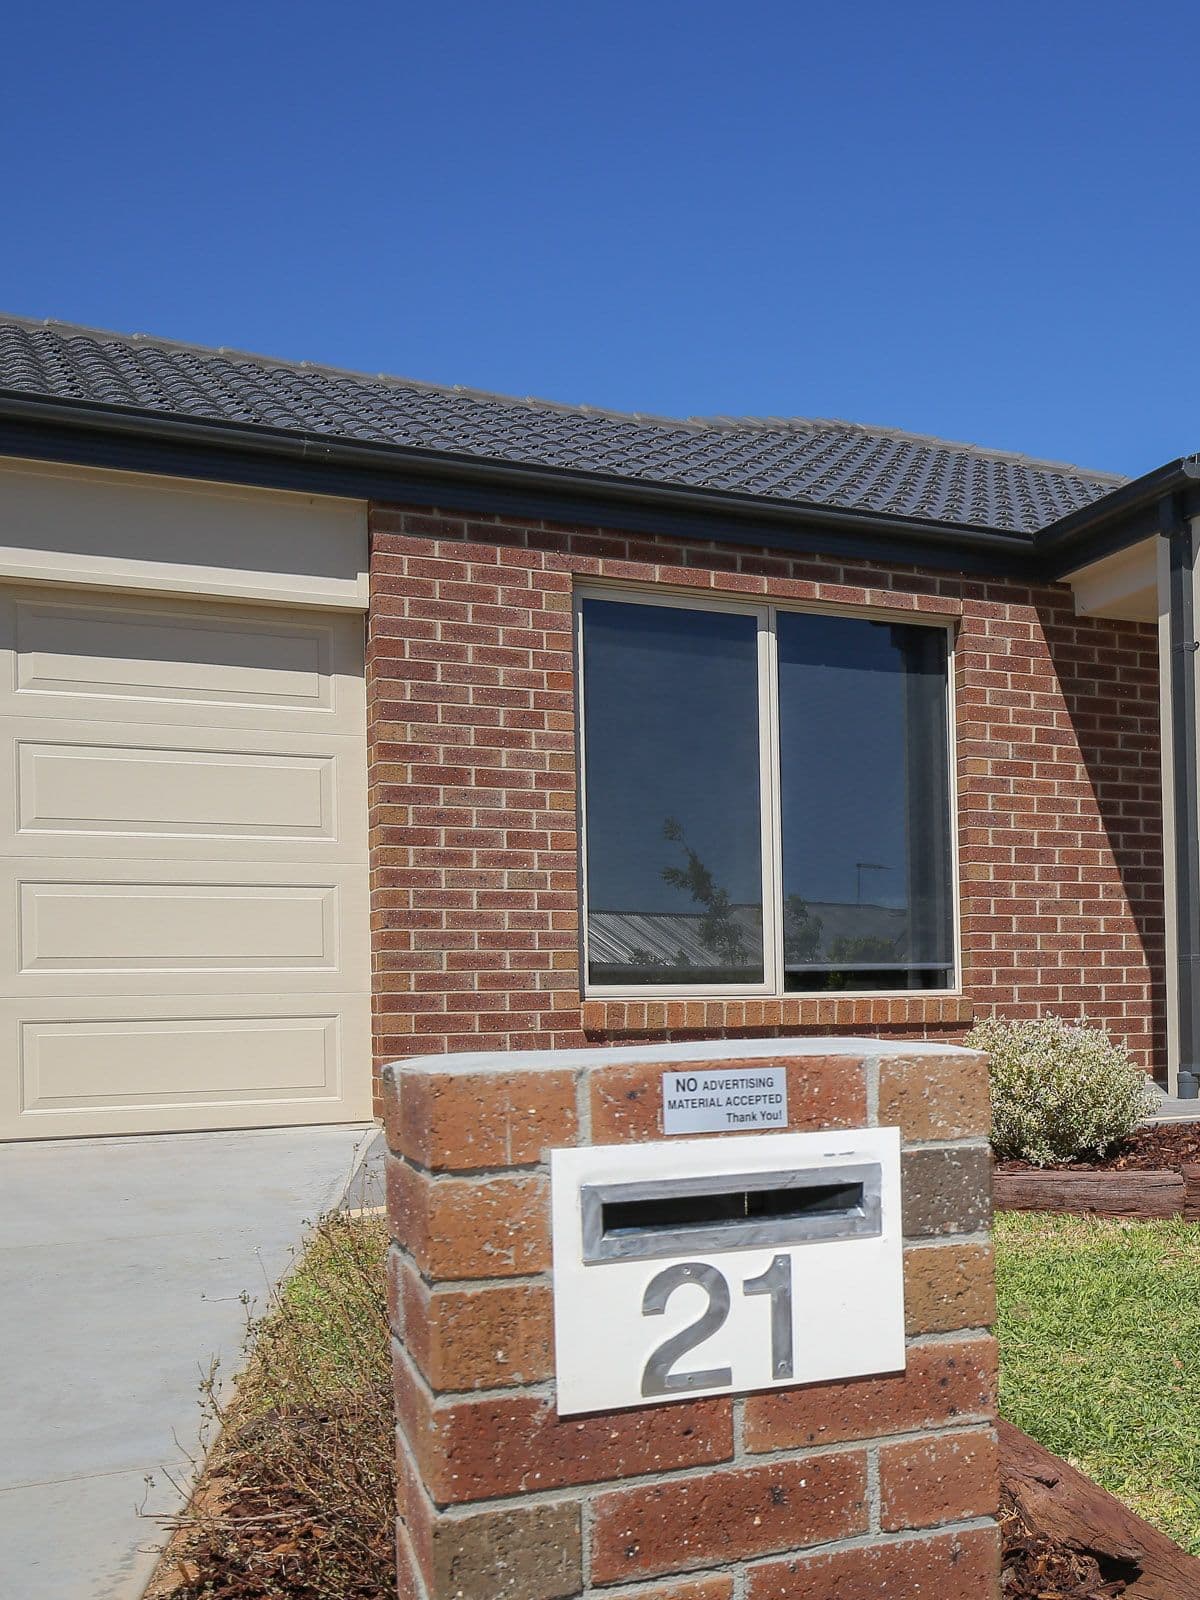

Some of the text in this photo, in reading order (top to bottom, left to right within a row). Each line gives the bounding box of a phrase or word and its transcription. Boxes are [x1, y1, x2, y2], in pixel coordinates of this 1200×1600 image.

[676, 1076, 774, 1093] NO ADVERTISING
[667, 1093, 783, 1110] MATERIAL ACCEPTED
[726, 1110, 783, 1123] Thank You!
[641, 1253, 793, 1398] 21
